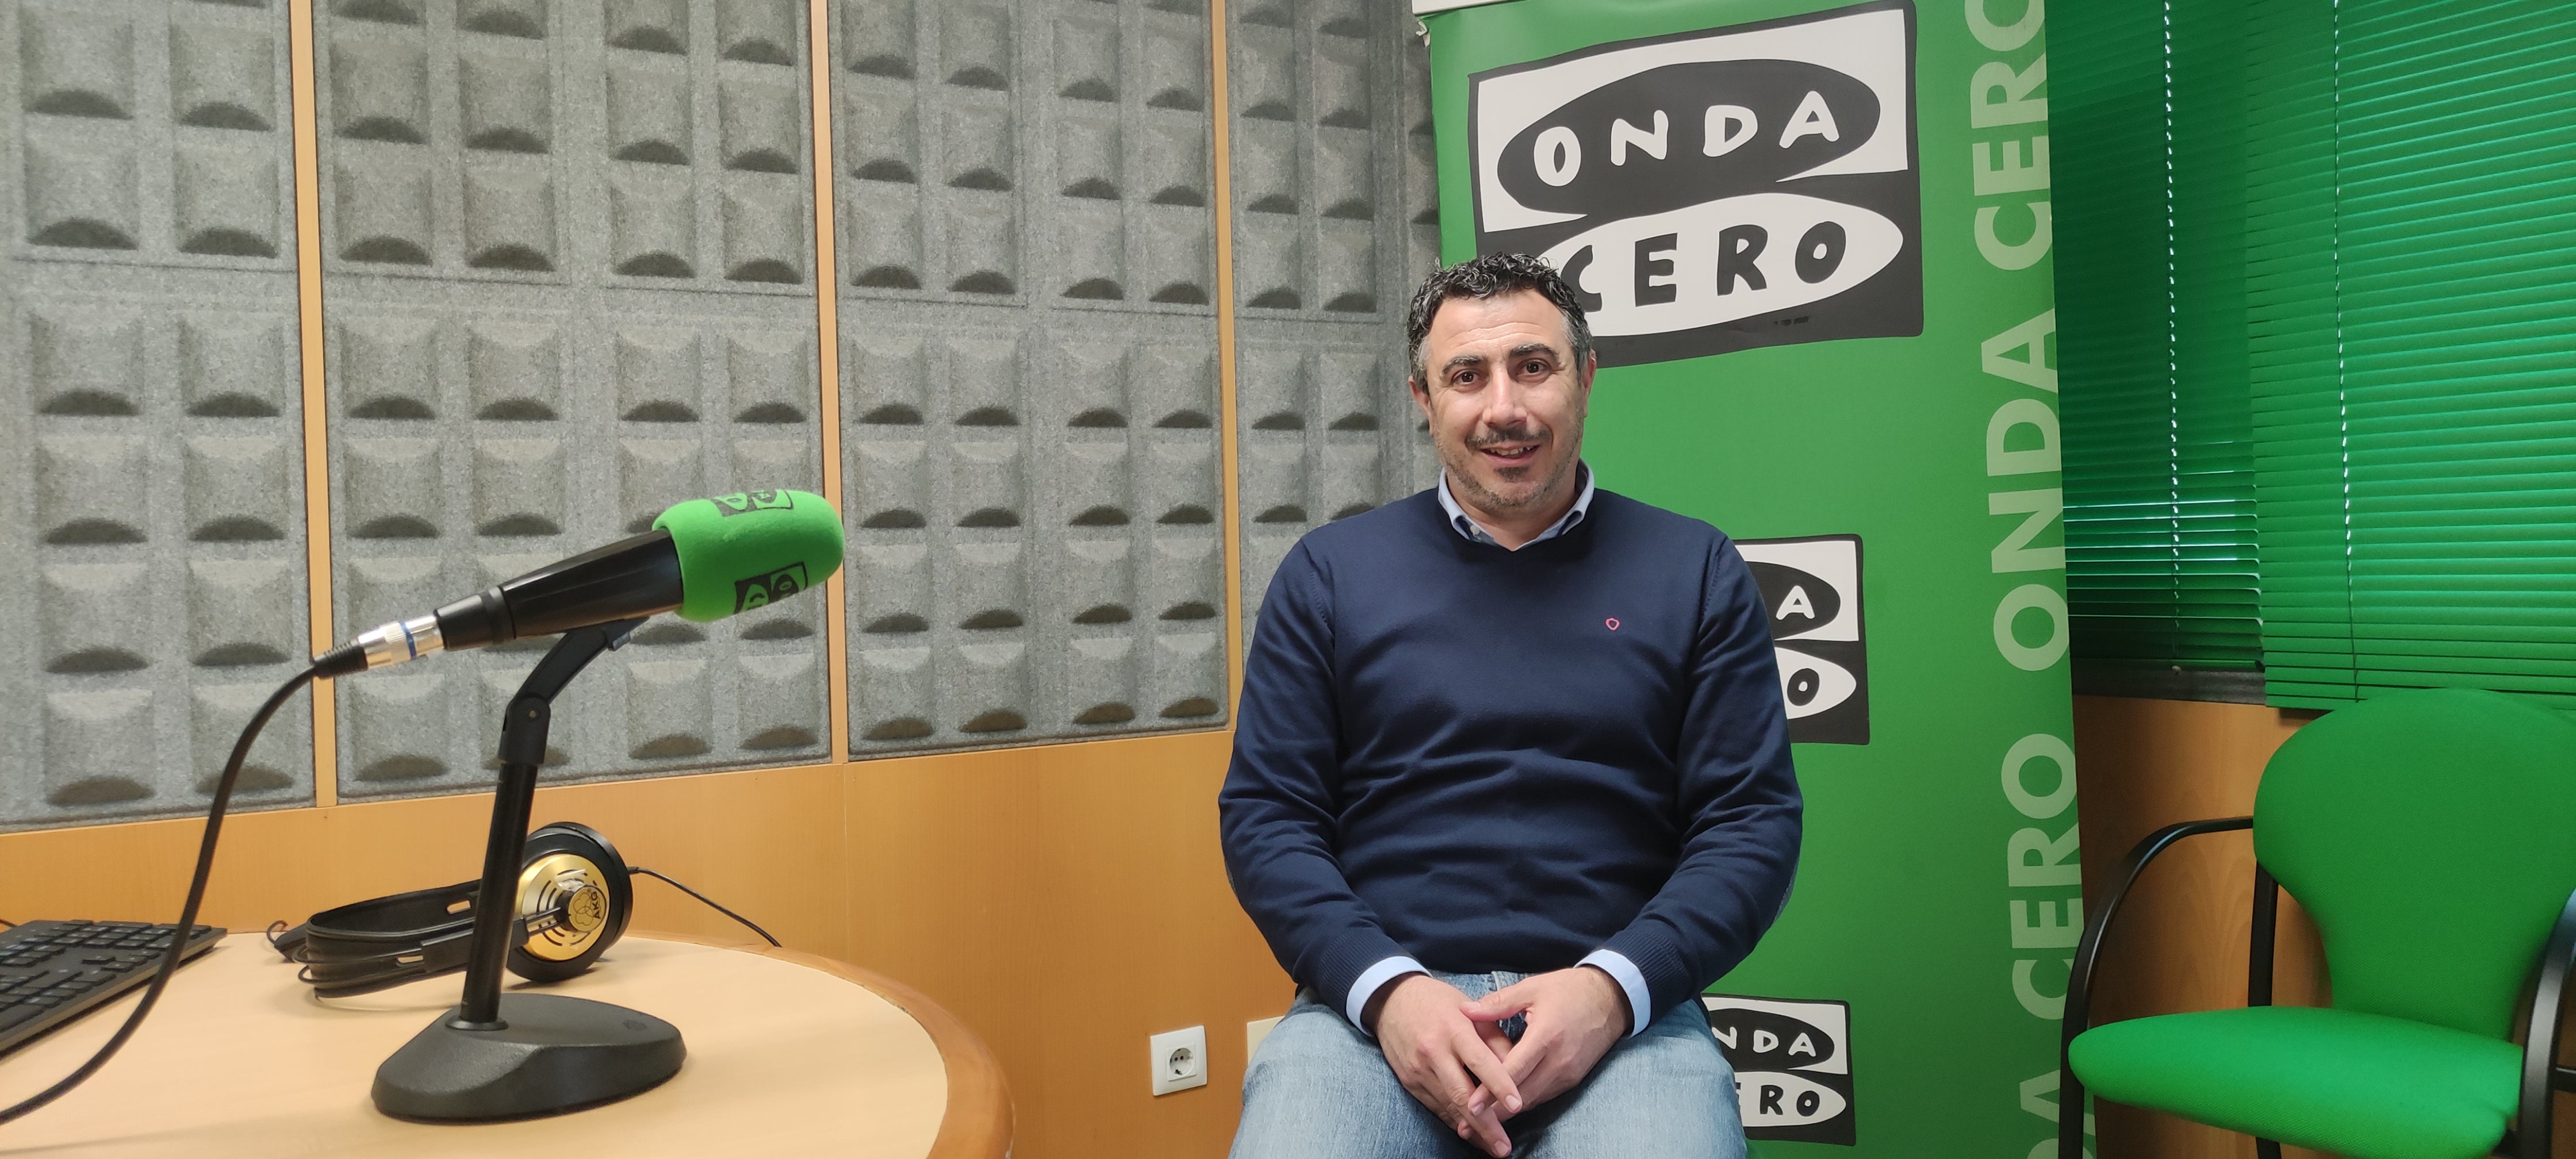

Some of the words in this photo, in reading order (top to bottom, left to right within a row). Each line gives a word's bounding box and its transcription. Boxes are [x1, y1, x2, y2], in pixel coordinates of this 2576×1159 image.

[1533, 90, 1840, 187] ONDA
[1560, 221, 1846, 313] CERO
[1981, 308, 2070, 671] ONDA
[591, 891, 601, 919] AKG
[1711, 1026, 1816, 1057] NDA
[1735, 1082, 1820, 1117] RO
